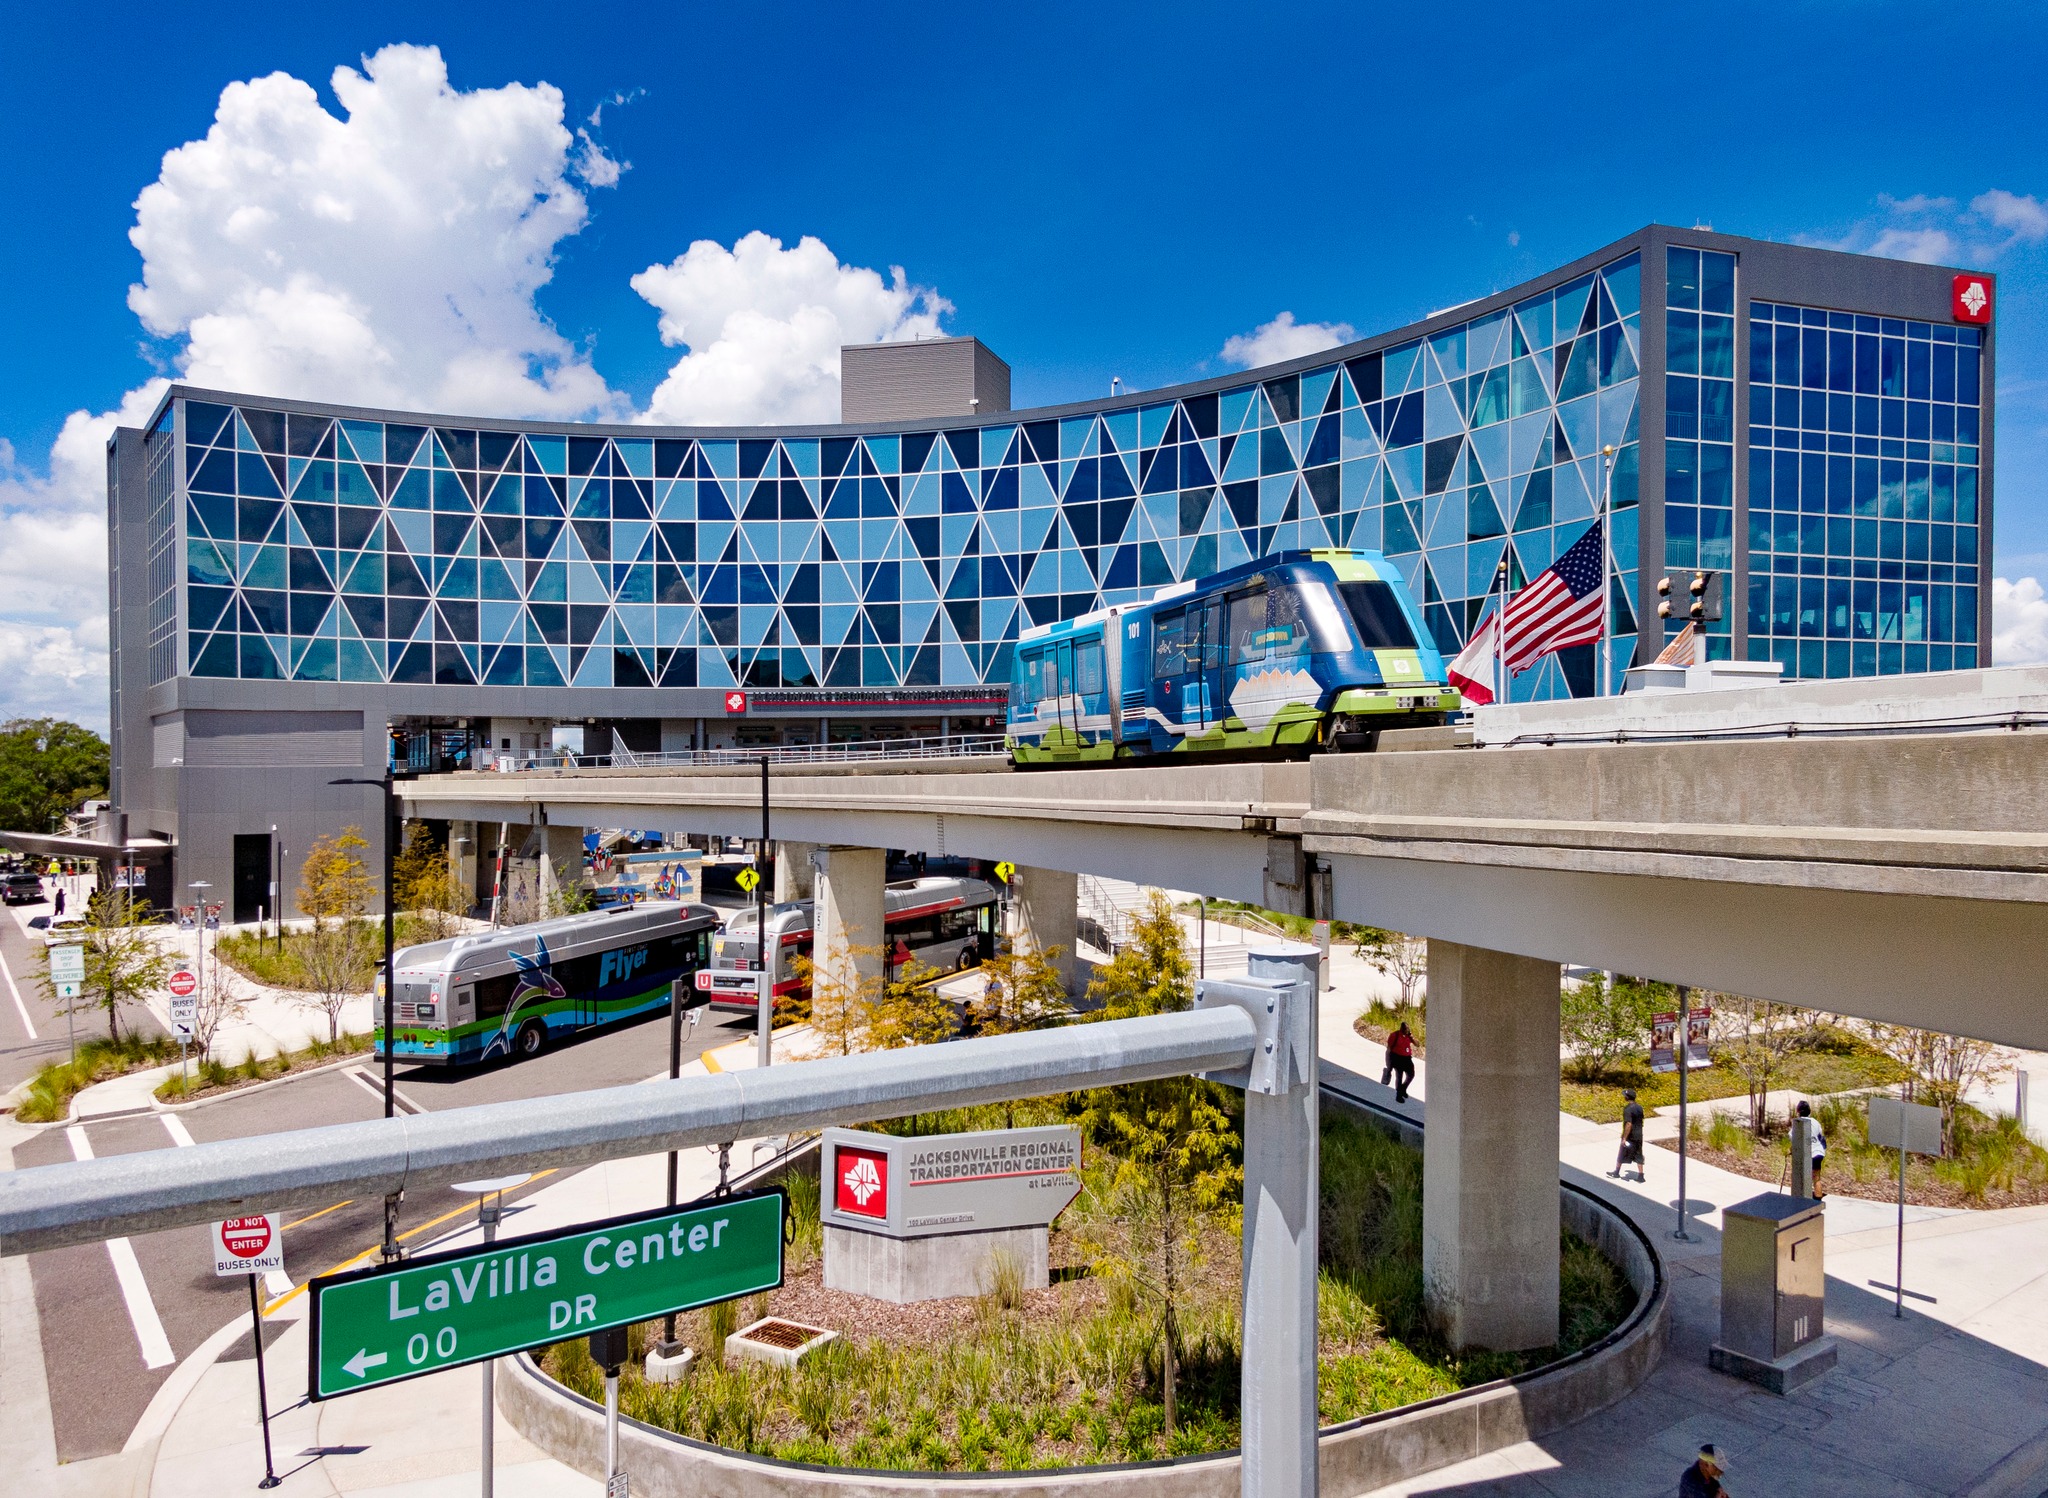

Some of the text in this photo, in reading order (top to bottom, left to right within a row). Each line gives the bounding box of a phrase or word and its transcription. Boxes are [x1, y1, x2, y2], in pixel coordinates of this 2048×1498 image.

[1128, 622, 1140, 640] 101
[836, 690, 888, 701] REGIONAL
[984, 688, 1009, 699] CEN
[599, 949, 649, 989] Flyer
[700, 975, 709, 987] U
[172, 999, 195, 1008] BUSES
[175, 1009, 192, 1018] ONLY
[910, 1140, 1074, 1167] JACKSONVILLE REGIONAL
[909, 1155, 1074, 1181] TRANSPORTATION CENTER
[1029, 1175, 1074, 1189] at LaVilla
[226, 1216, 264, 1229] DO NOT
[231, 1238, 264, 1250] ENTER
[217, 1256, 281, 1271] BUSES ONLY
[389, 1218, 730, 1321] LaVilla Center
[549, 1293, 597, 1332] DR
[406, 1326, 458, 1365] 00
